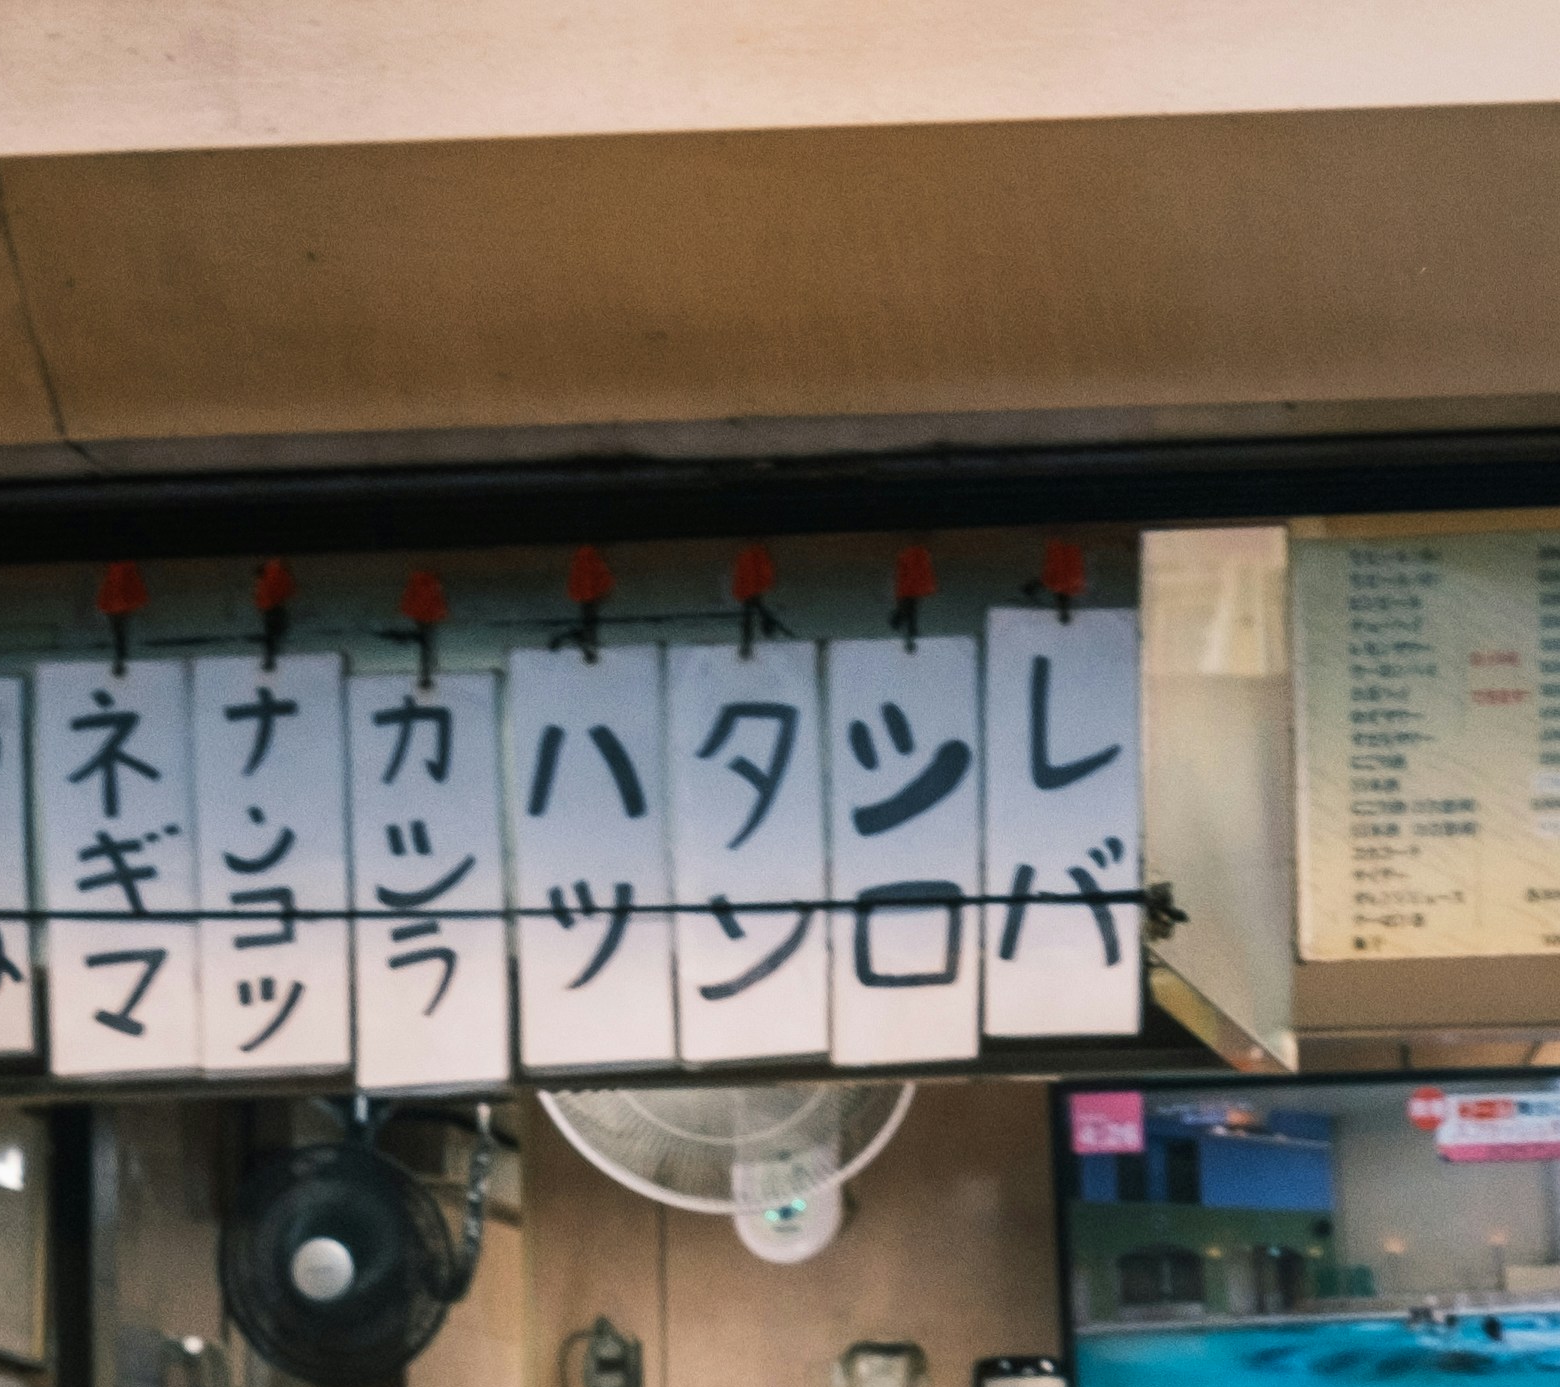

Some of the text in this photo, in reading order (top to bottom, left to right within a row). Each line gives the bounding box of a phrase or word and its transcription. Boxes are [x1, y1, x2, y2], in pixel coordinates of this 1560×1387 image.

[68, 690, 181, 1036] ネギマ
[223, 686, 306, 1053] ナンコツ
[373, 694, 477, 1019] カシラ
[527, 724, 648, 991] ハツ
[697, 701, 818, 1002] タン
[847, 700, 973, 987] シロ
[998, 654, 1126, 967] レバ
